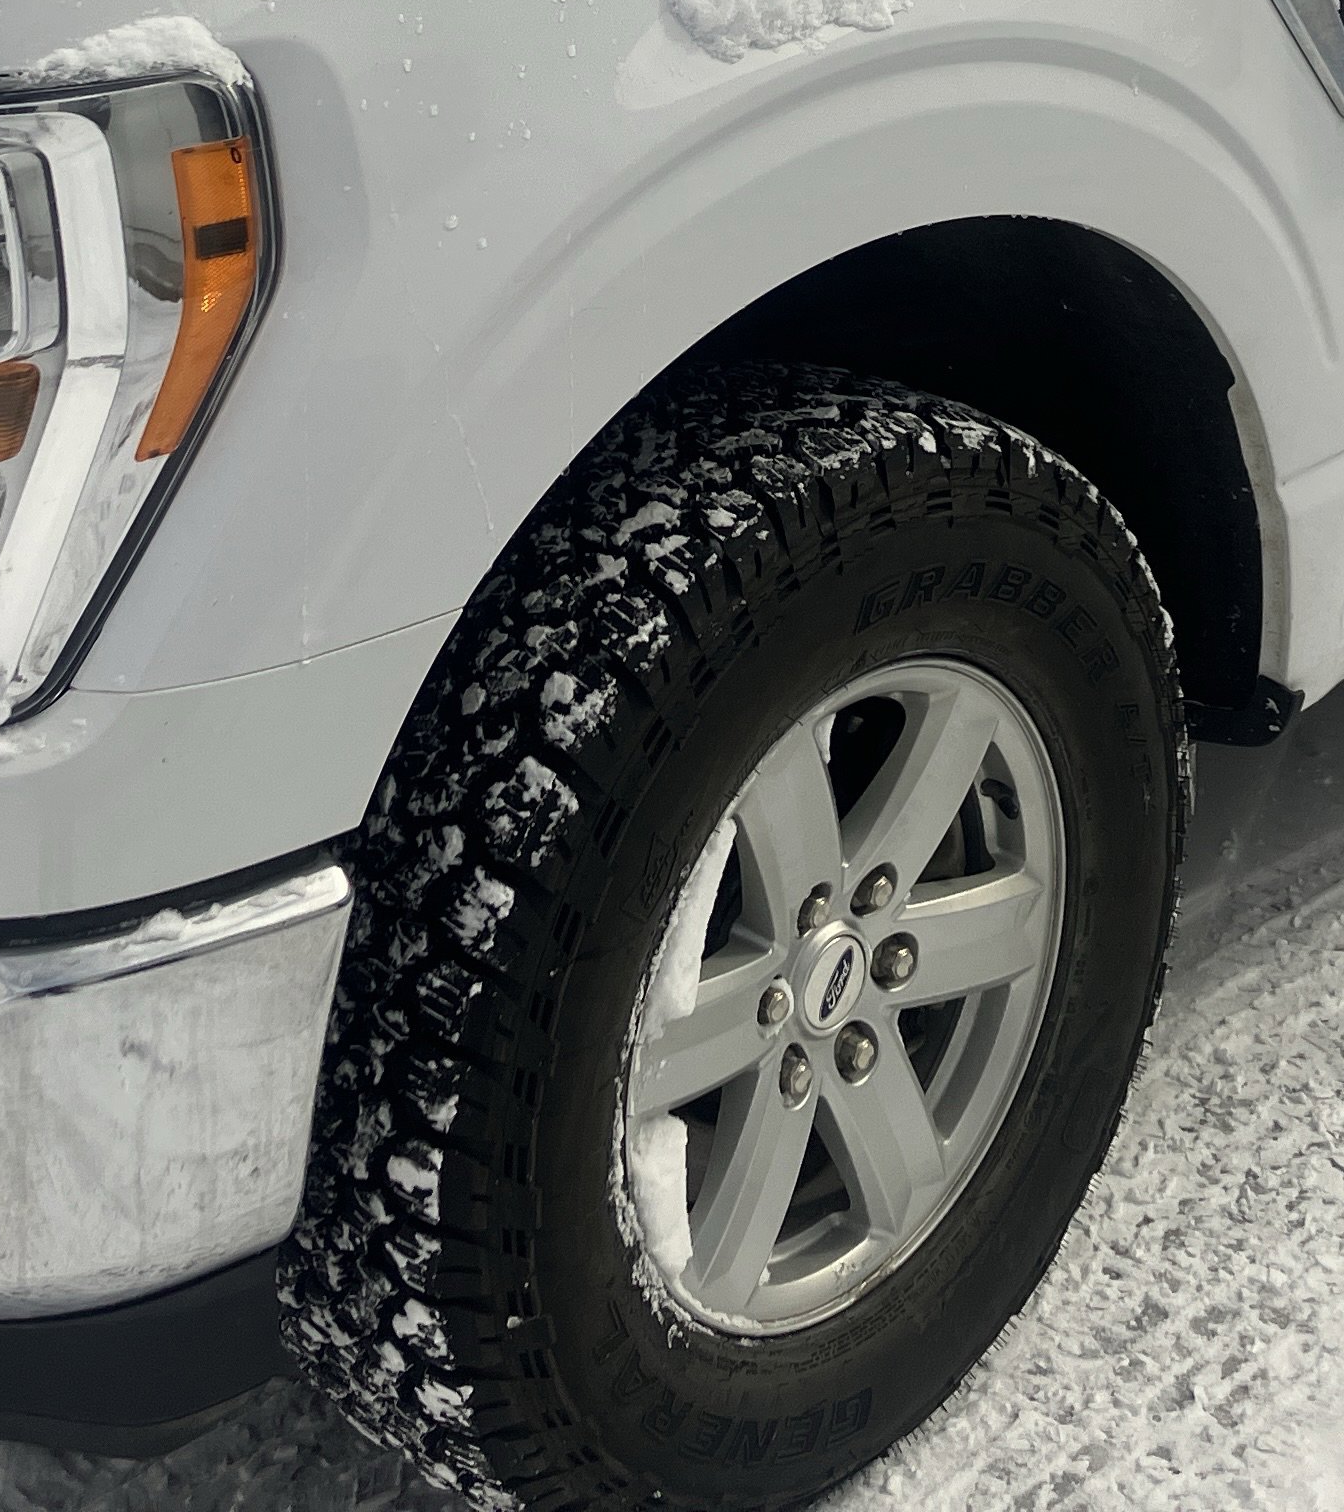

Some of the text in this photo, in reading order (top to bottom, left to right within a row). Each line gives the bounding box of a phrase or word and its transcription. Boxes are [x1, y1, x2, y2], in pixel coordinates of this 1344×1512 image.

[852, 559, 1122, 686] GRABBER
[825, 958, 851, 1010] Ford
[591, 1299, 874, 1468] GENERAL
